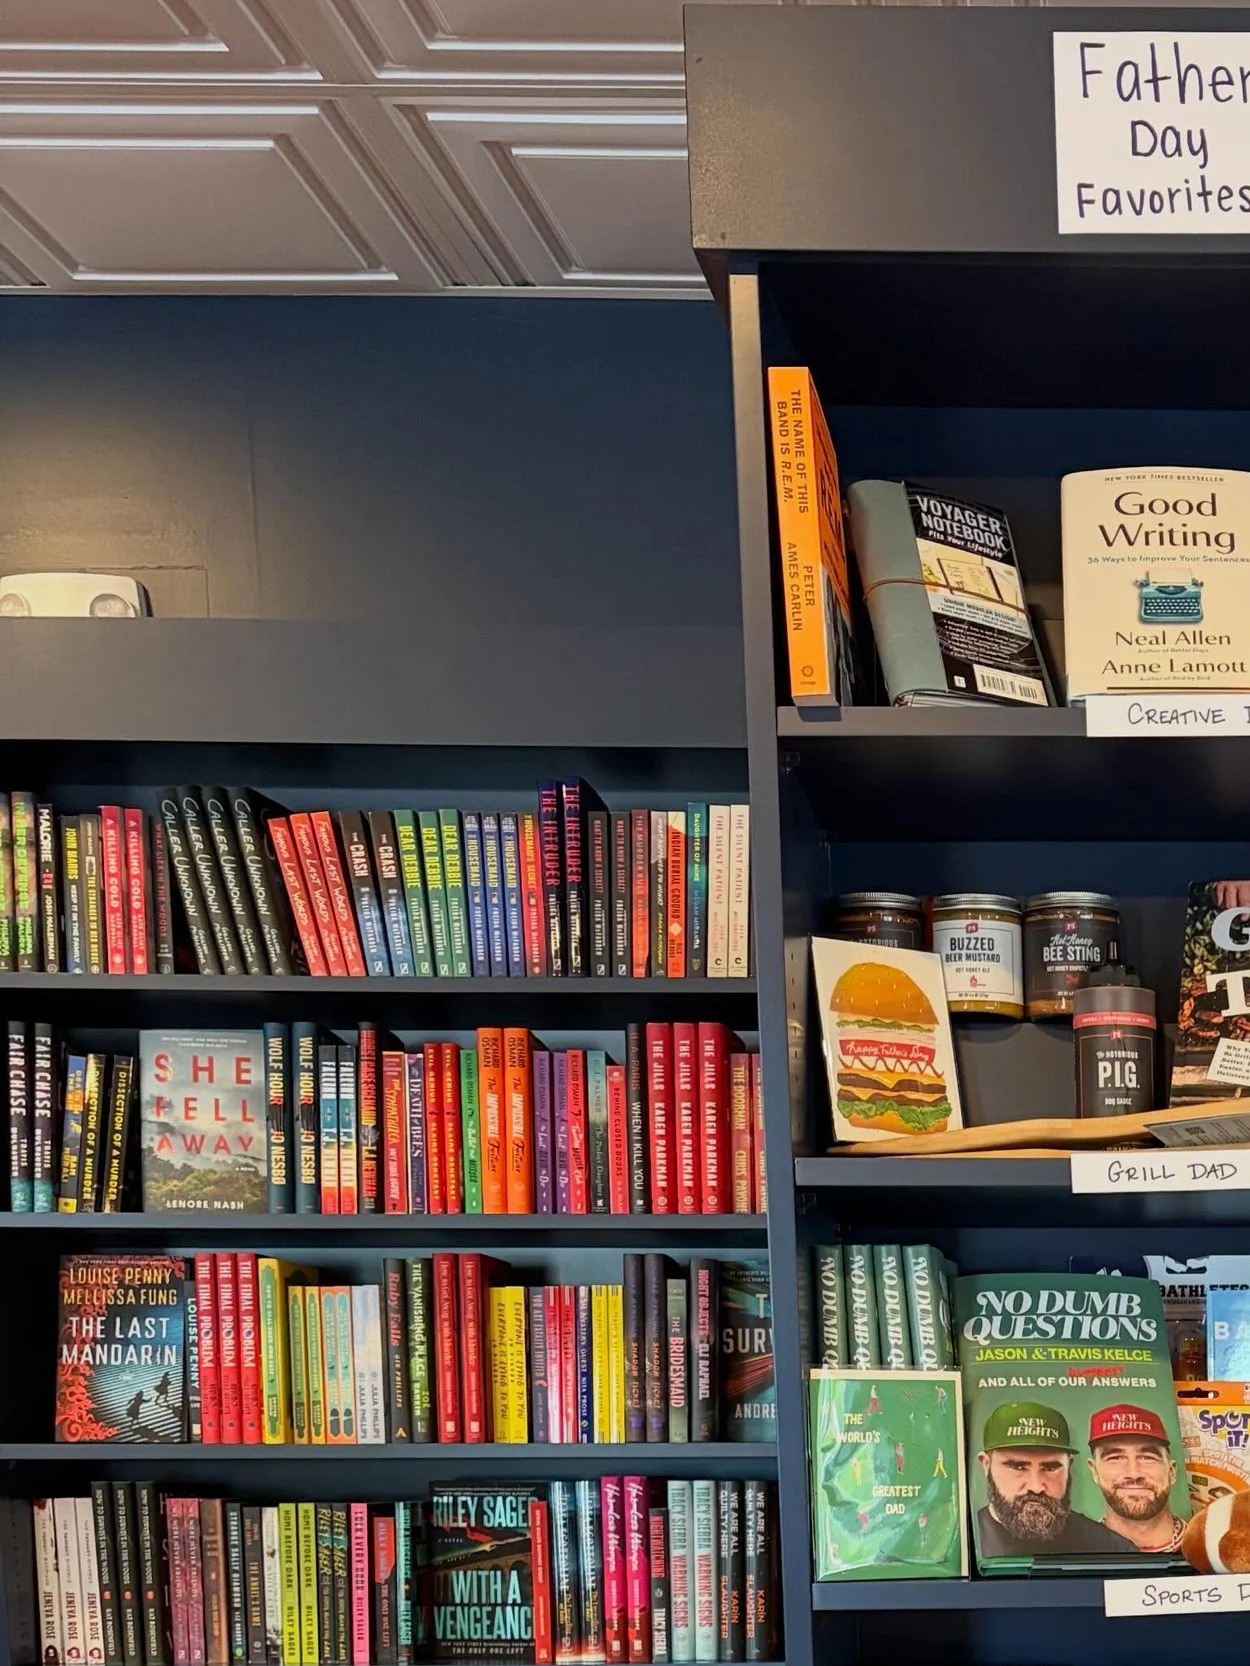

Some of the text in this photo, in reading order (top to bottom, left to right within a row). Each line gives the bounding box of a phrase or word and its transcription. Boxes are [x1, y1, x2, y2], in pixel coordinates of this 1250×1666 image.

[1130, 120, 1209, 169] Day
[1114, 491, 1218, 517] Good
[916, 495, 1004, 536] VOYAGER
[921, 512, 1006, 551] NOTEBOOK
[1098, 522, 1236, 554] Writing
[1087, 556, 1099, 564] 36
[1102, 556, 1124, 564] Ways
[1140, 556, 1177, 564] Improve
[1115, 630, 1232, 646] Neal Allen
[1102, 658, 1248, 674] Anne Lamott
[1128, 702, 1226, 724] CREATIVE
[950, 937, 995, 952] BUZZED
[1043, 946, 1100, 962] BEE STING
[945, 953, 1001, 963] BEER MUSTARD
[154, 1053, 254, 1086] SHE
[1098, 1061, 1140, 1089] P.I.G.
[154, 1096, 256, 1124] FELL
[155, 1134, 256, 1156] AWAY
[1108, 1160, 1237, 1183] GRILL DAD
[166, 1199, 245, 1210] LENORE NASH
[69, 1267, 174, 1284] LOUISE PENNY
[63, 1289, 178, 1306] MELLISSA FUNG
[977, 1290, 1142, 1316] NO DUMB
[68, 1316, 171, 1339] THE LAST
[963, 1317, 1157, 1345] QUESTIONS
[61, 1344, 178, 1366] MANDARIN
[975, 1347, 1152, 1362] JASON & TRAVIS KELCE
[978, 1377, 1157, 1388] AND ALL OF OUR ANSWERS
[1141, 1585, 1222, 1608] SPORTS
